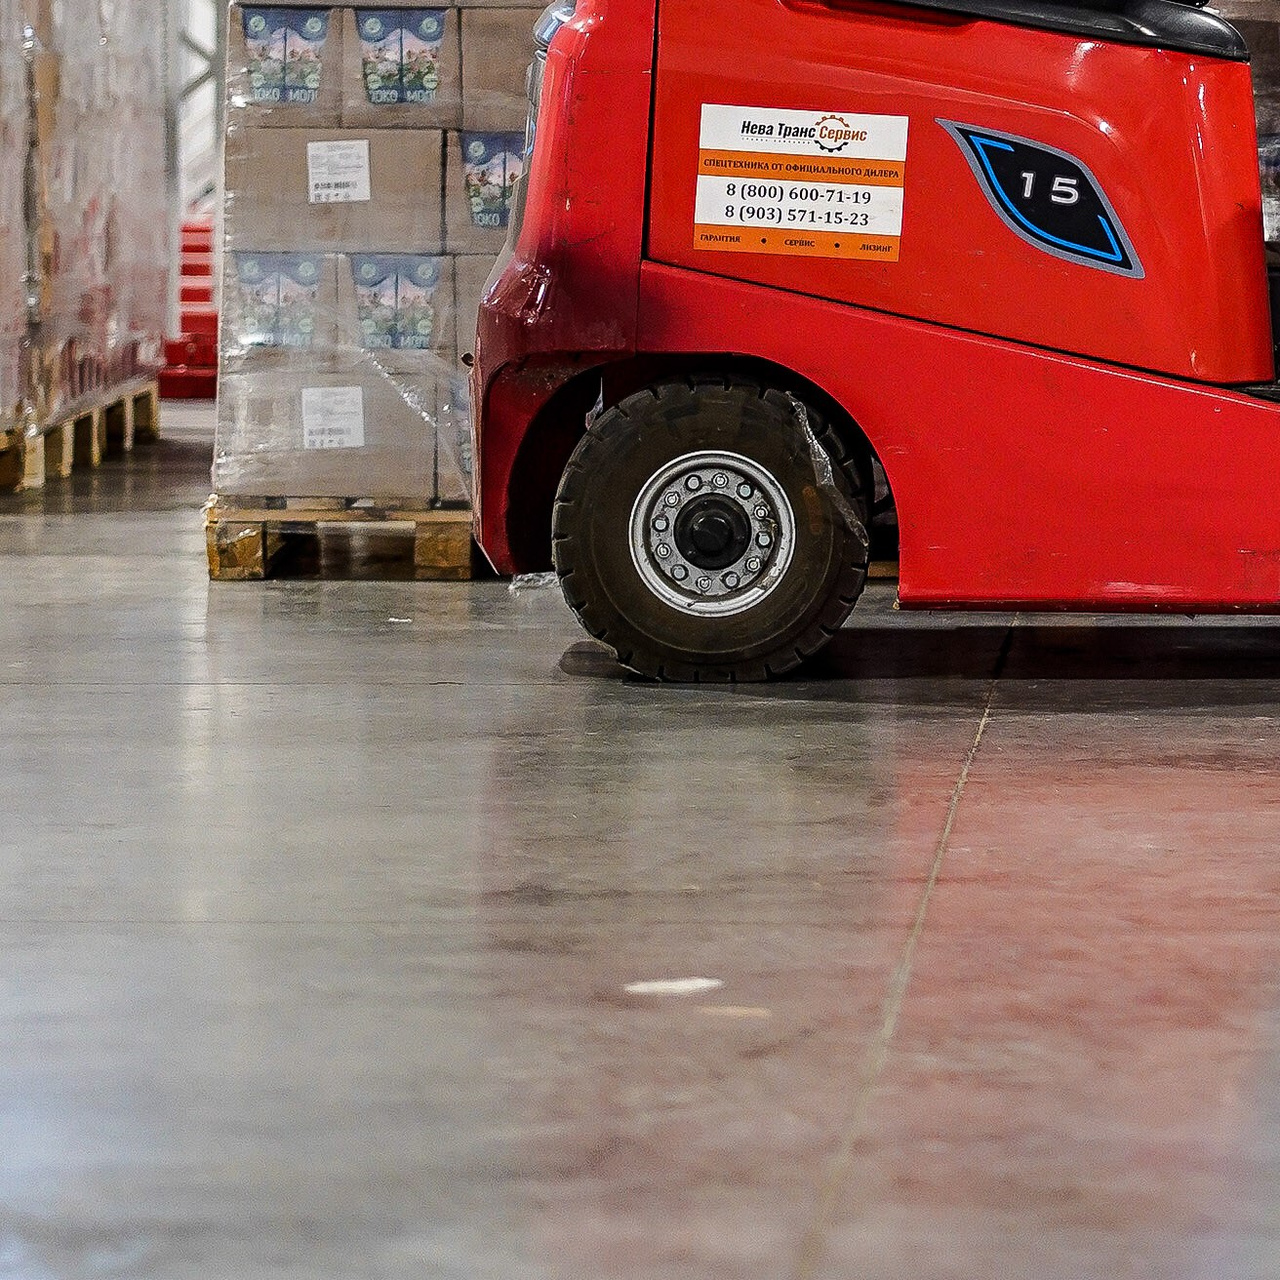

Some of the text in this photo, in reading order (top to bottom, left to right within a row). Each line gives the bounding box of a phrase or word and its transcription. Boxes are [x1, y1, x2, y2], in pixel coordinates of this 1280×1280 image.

[741, 120, 774, 136] Нева
[778, 123, 817, 139] Транс
[819, 125, 868, 143] Сервис
[703, 158, 900, 178] СПЕЦТЕХНИКА ОТ ОФИЦИАЛЬНОГО ДИЛЕРА
[726, 183, 872, 204] 8 (800) 600-71-19
[725, 204, 869, 227] 8 (903) 571-15-23
[700, 233, 894, 253] ГАРАНТИЯ СЕРВИС ЛИЗИНГ
